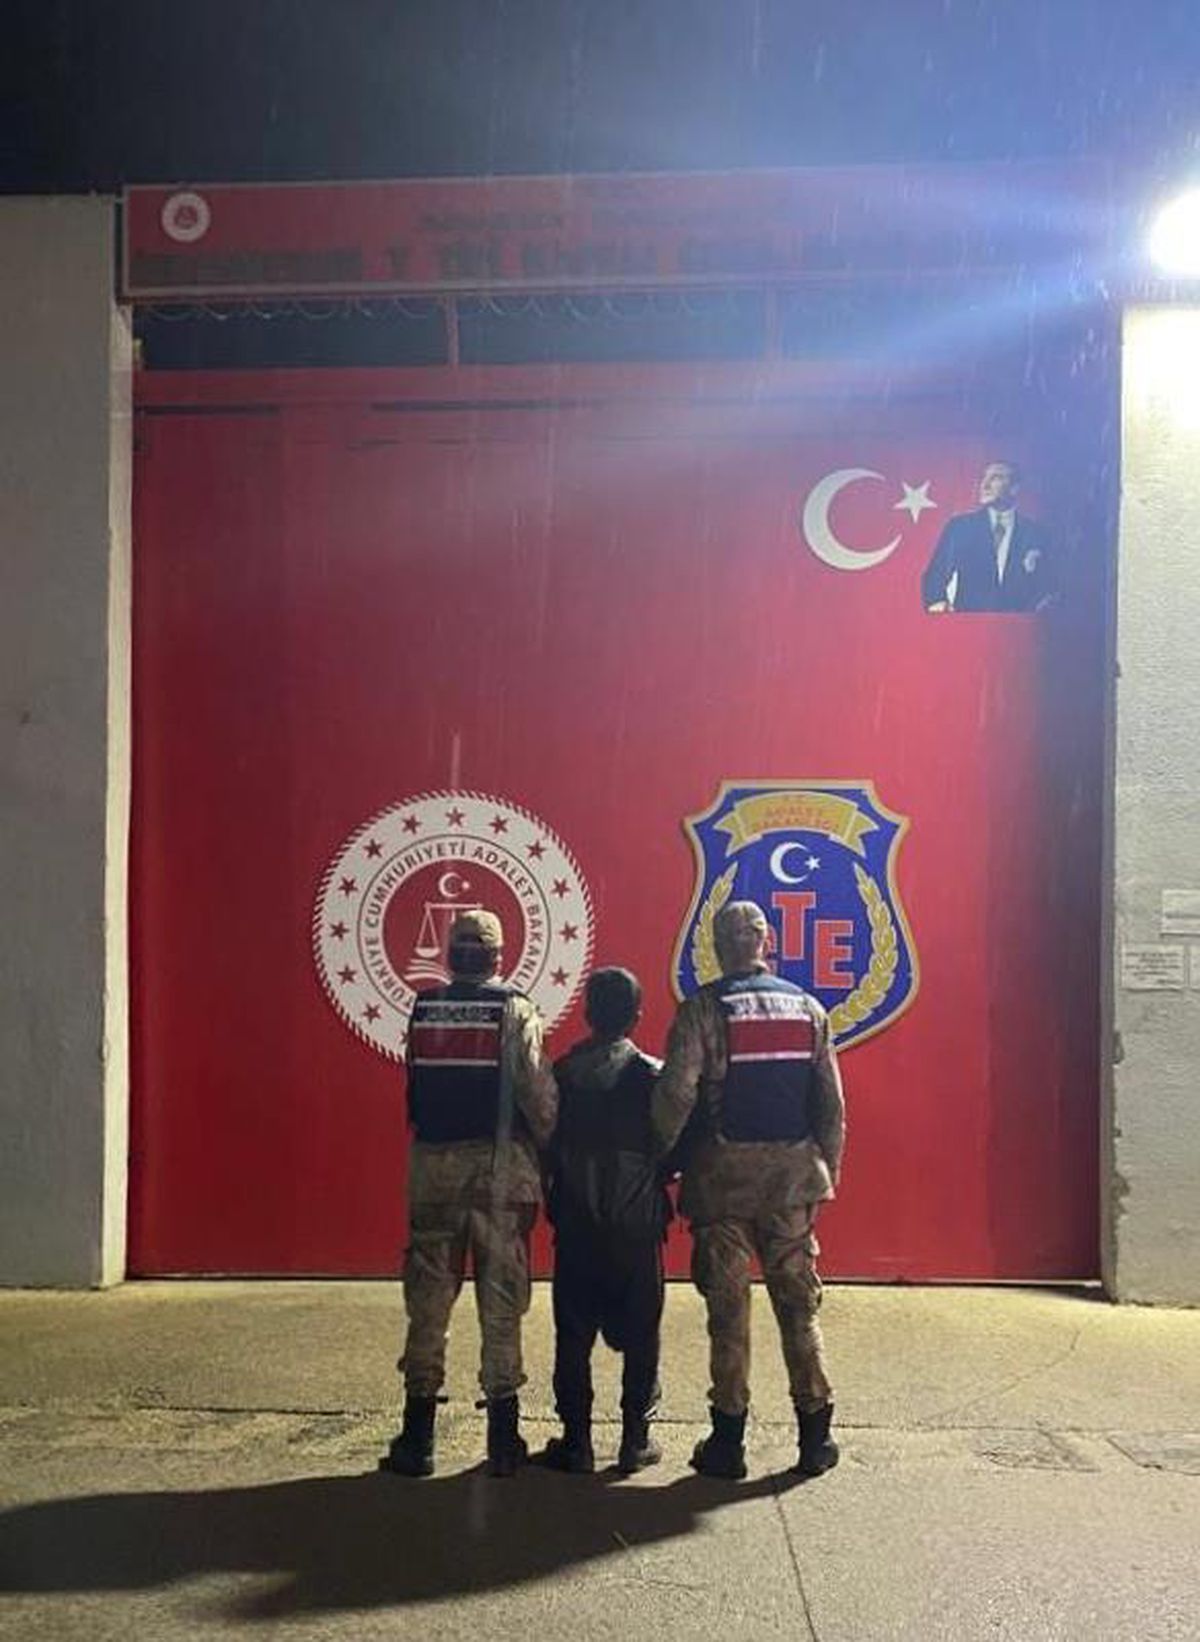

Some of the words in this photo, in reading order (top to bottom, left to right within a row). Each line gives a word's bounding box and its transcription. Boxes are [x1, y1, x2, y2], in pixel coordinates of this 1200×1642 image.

[365, 841, 467, 928] CUMHURİYETİ
[474, 845, 534, 898] ADALET
[513, 905, 543, 991] BAKANLI
[768, 891, 855, 989] TE
